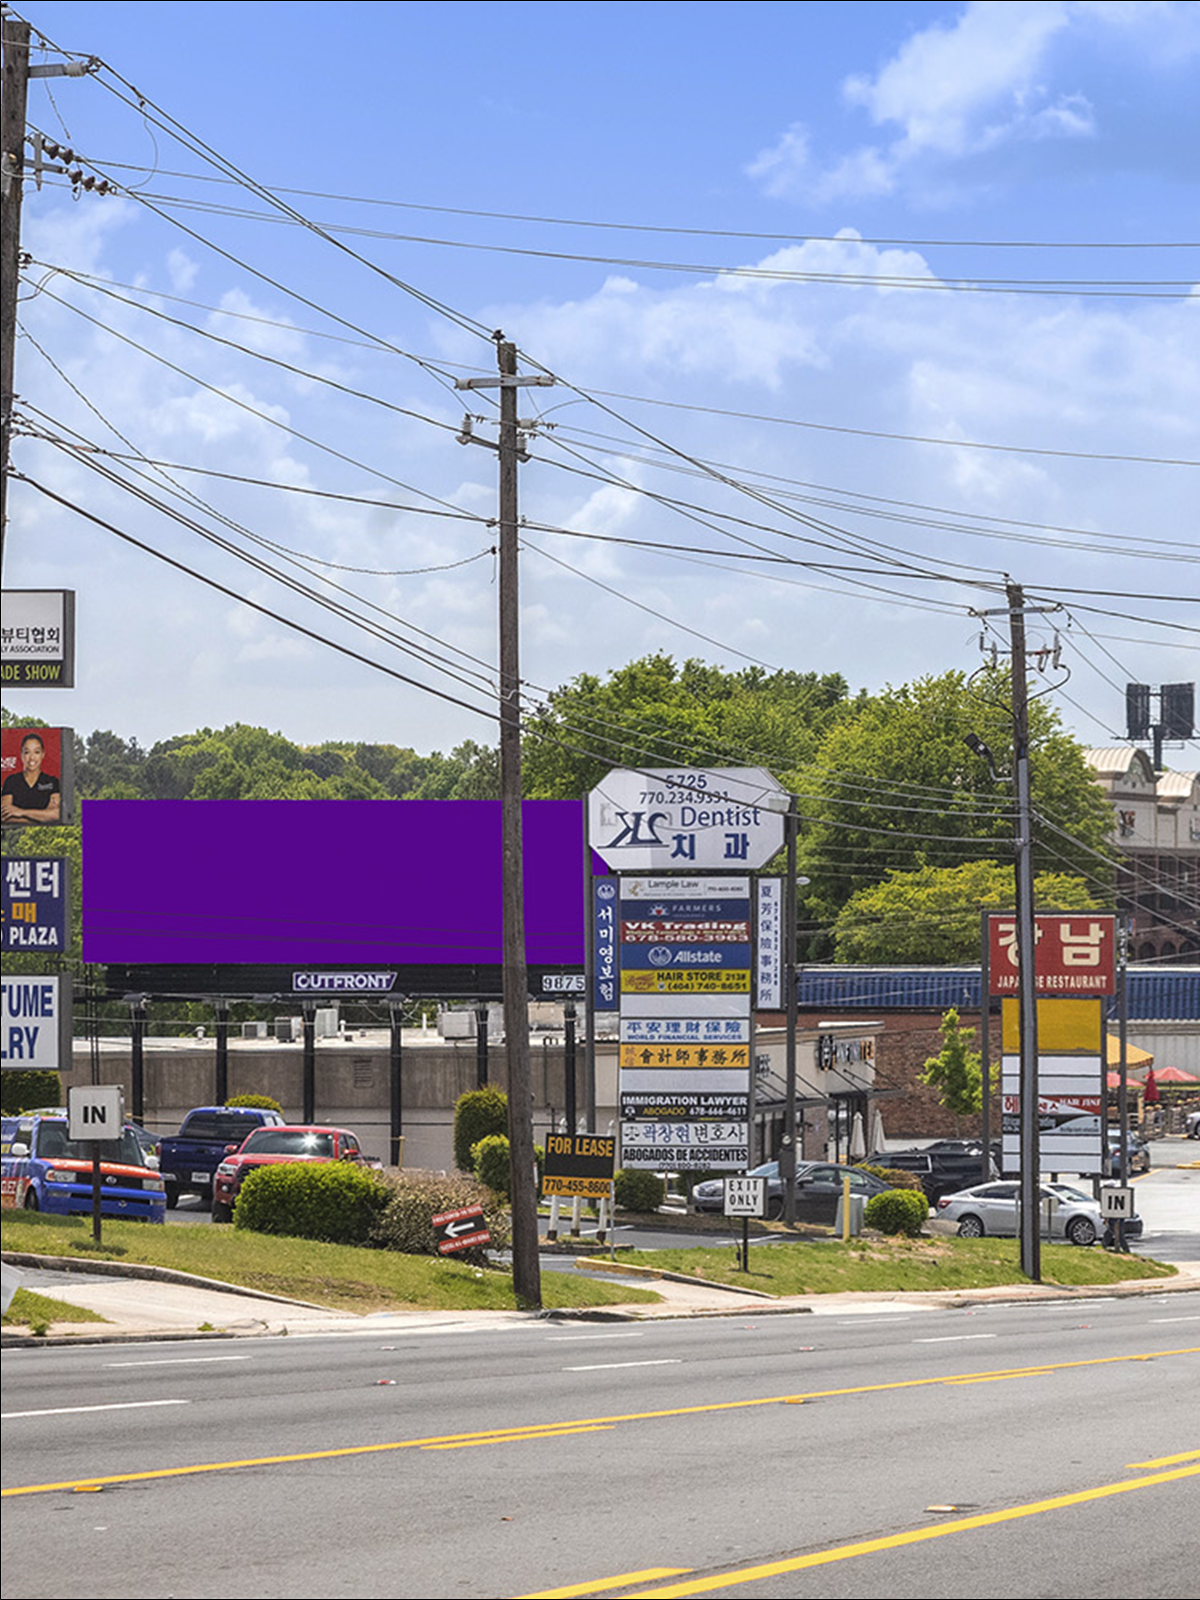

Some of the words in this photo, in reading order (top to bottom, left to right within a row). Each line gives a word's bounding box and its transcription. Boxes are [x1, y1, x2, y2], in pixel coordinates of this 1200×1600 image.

[25, 665, 61, 680] SHOW
[665, 774, 707, 789] 5725
[681, 805, 761, 827] Dentist
[6, 862, 60, 898] 쎈터
[681, 880, 699, 889] Law
[672, 904, 721, 913] FARMERS
[625, 922, 655, 930] VK
[661, 922, 747, 930] Trading
[10, 927, 58, 945] PLAZA
[673, 951, 722, 963] Allstate
[297, 975, 391, 988] OUTFRONT
[544, 976, 585, 990] 9875
[657, 972, 684, 981] HAIR
[687, 972, 721, 981] STORE
[1046, 975, 1107, 988] RESTAURANT
[622, 1096, 697, 1106] IMMIGRATION
[701, 1096, 748, 1106] LAWYER
[83, 1106, 106, 1124] IN
[643, 1107, 686, 1116] ABOGADO
[548, 1137, 572, 1155] FOR
[575, 1138, 613, 1157] LEASE
[623, 1148, 675, 1161] ABOGADOS
[676, 1148, 688, 1161] DE
[729, 1181, 758, 1191] EXIT
[729, 1194, 758, 1205] ONLY
[1108, 1195, 1125, 1210] IN
